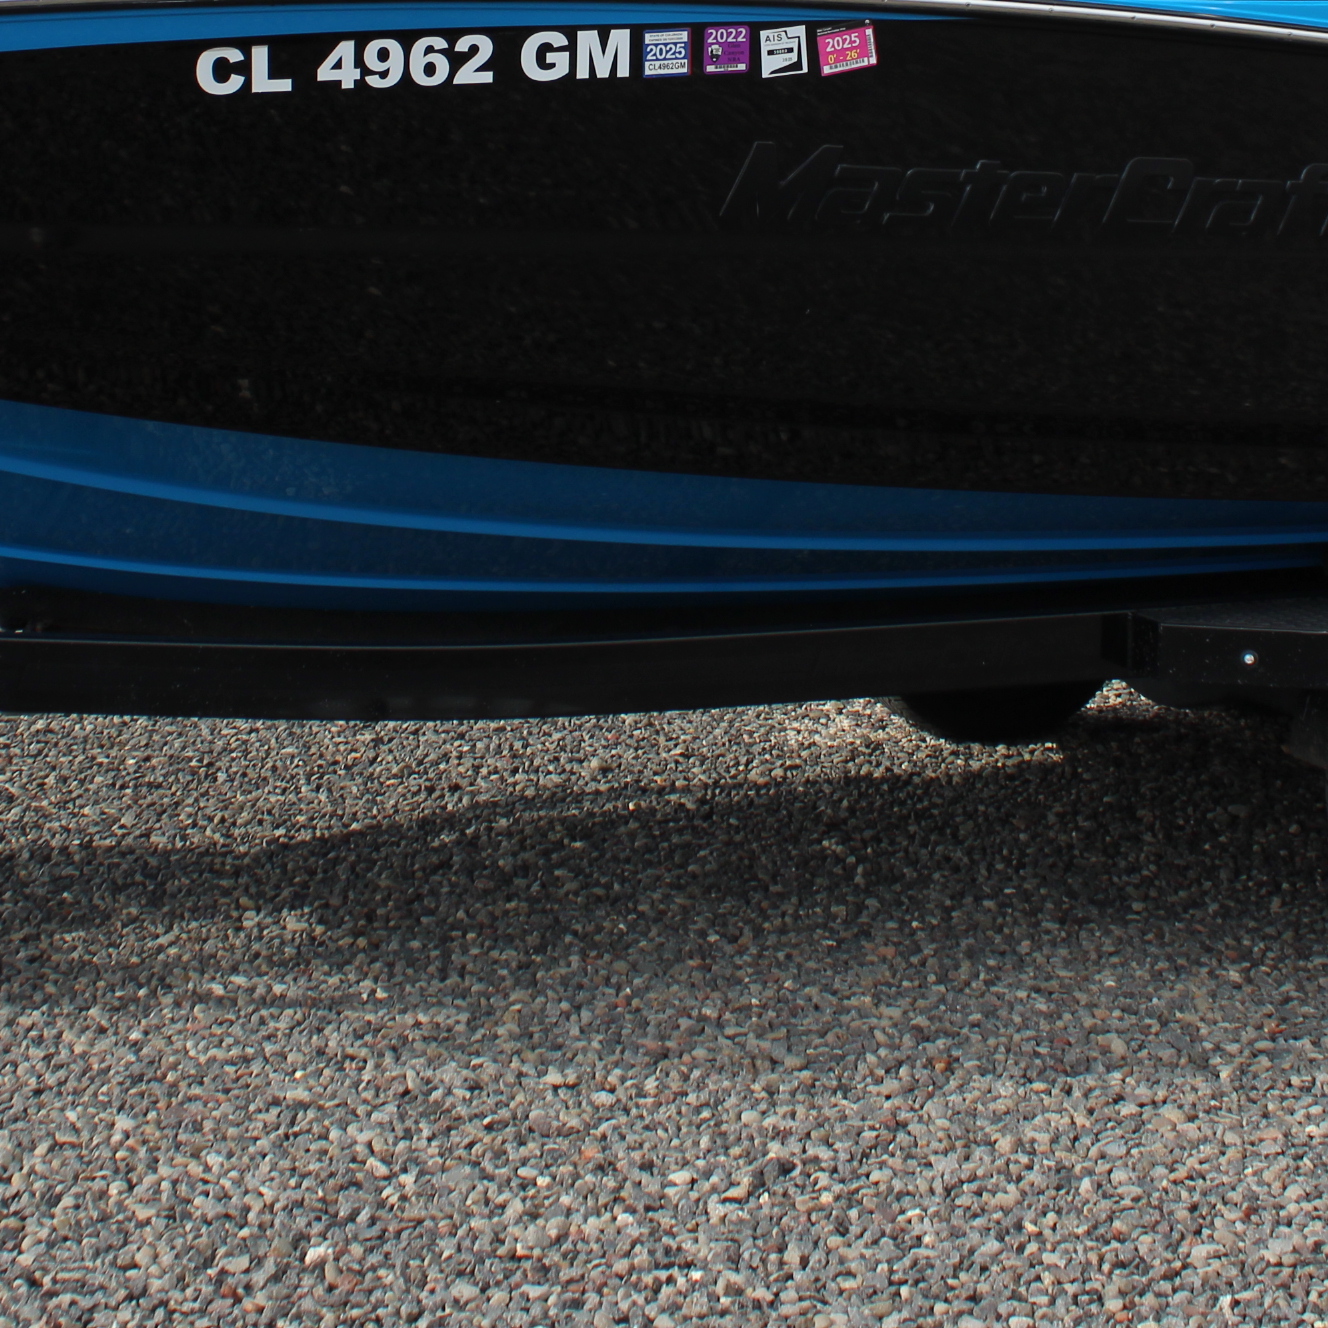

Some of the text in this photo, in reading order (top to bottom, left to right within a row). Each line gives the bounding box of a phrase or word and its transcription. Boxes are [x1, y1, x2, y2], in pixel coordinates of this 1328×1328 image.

[707, 28, 746, 43] 2022
[764, 33, 783, 43] AIS
[825, 33, 860, 52] 2025
[646, 43, 685, 60] 2025
[196, 28, 630, 95] CL 4962 GM
[648, 62, 686, 71] CL4962GM
